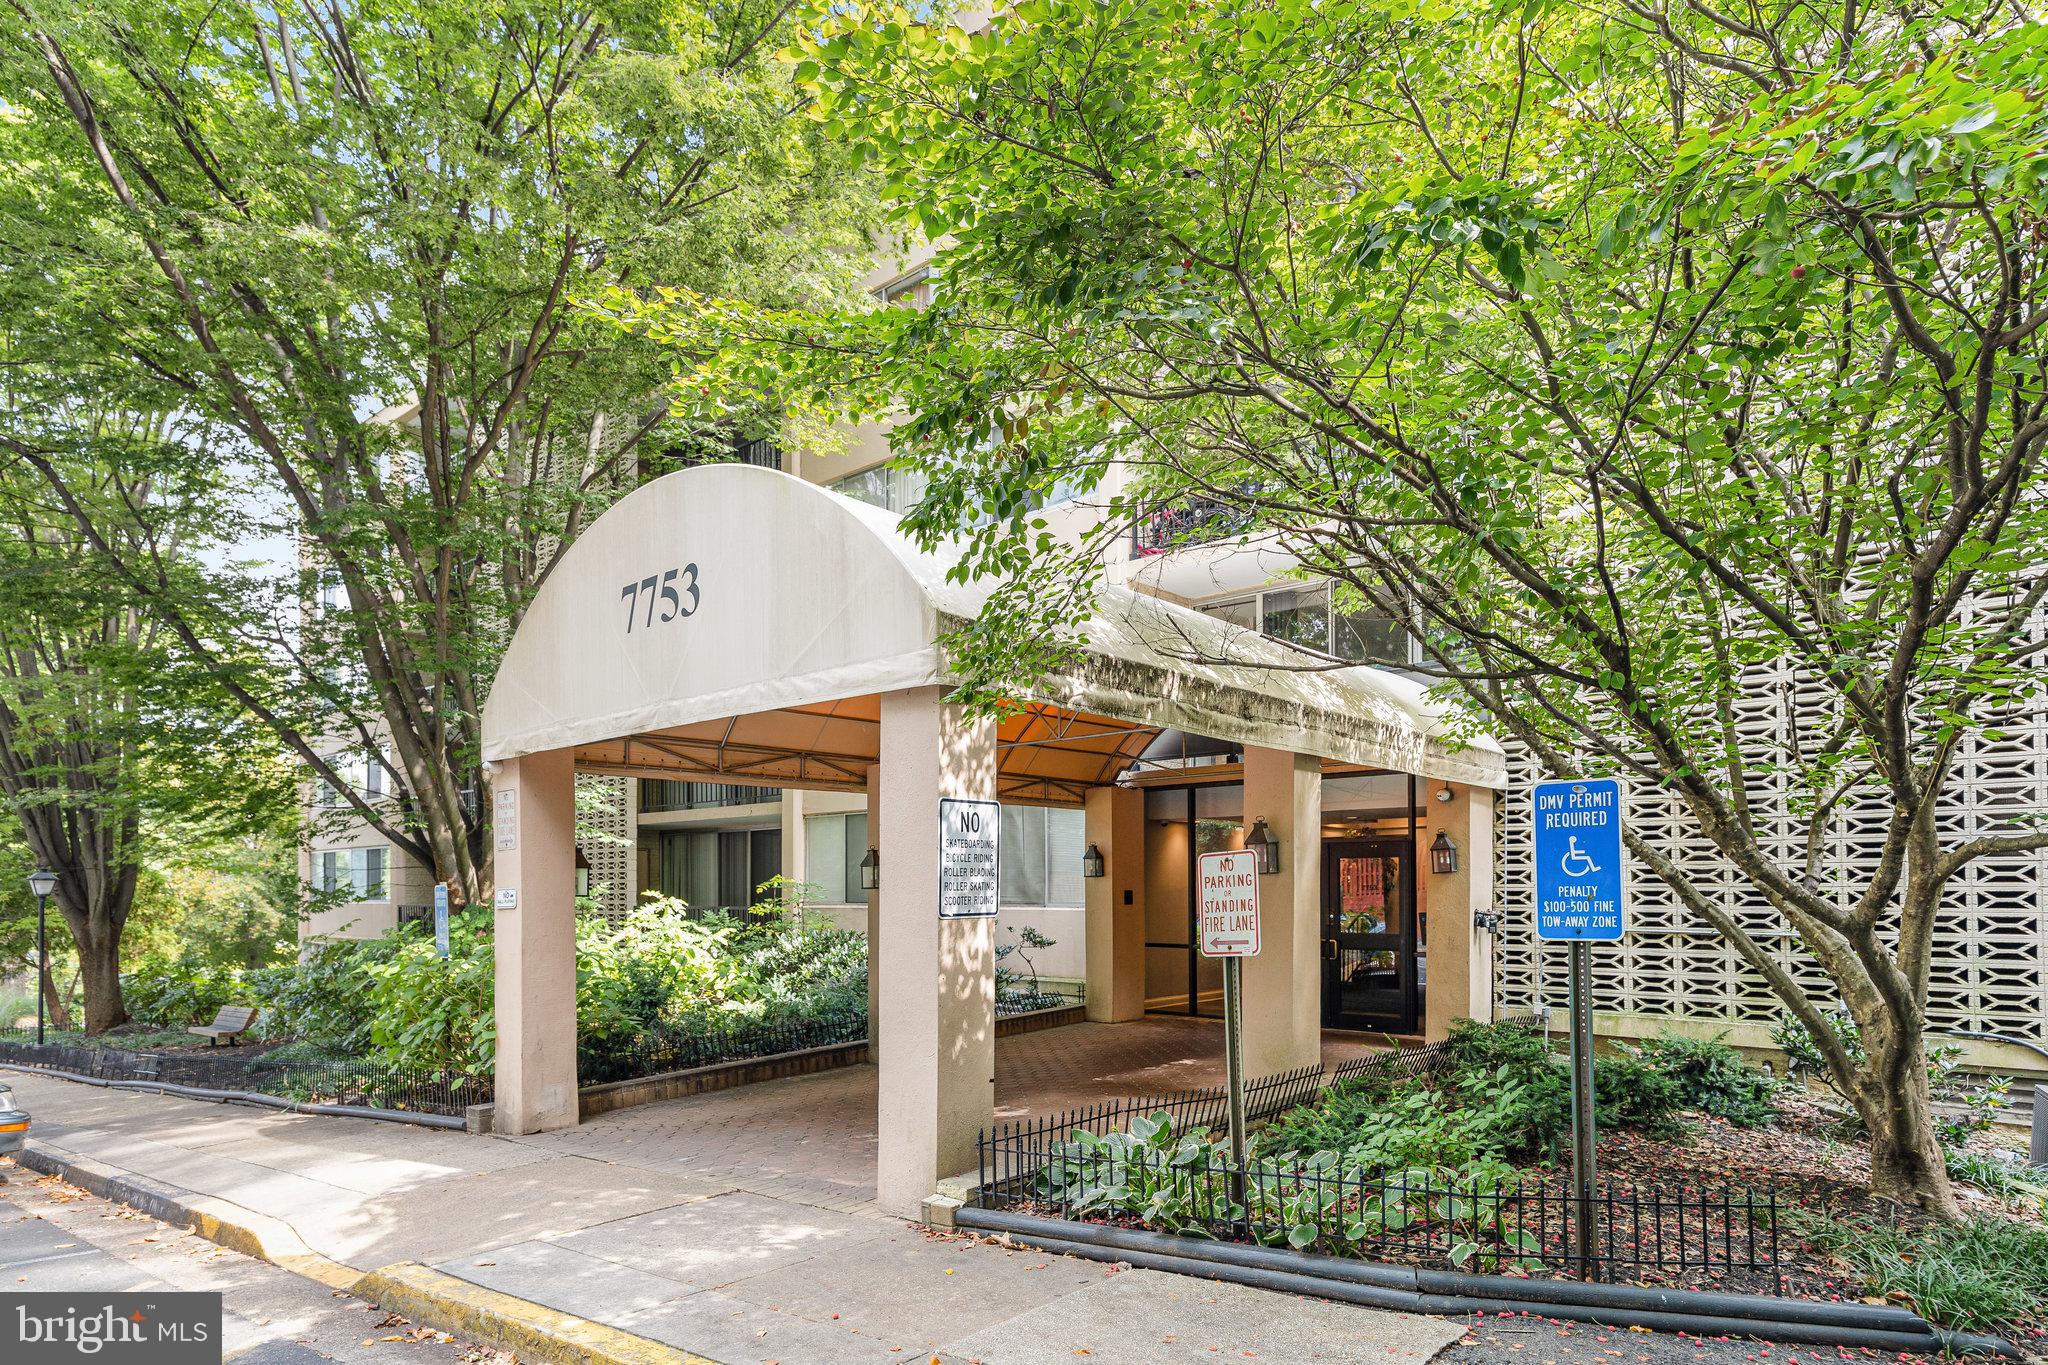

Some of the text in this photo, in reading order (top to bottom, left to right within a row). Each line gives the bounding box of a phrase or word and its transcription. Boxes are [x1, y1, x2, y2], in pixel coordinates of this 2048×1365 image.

[620, 562, 700, 634] 7753
[1539, 791, 1613, 810] DMV PERMIT
[960, 811, 980, 833] NO
[1546, 810, 1607, 829] REQUIRED
[945, 838, 995, 849] SKATEBOARDING
[945, 853, 994, 863] BICYCLE RIDING
[943, 867, 995, 877] ROLLER BLADING
[1219, 859, 1234, 872] NO
[943, 881, 995, 892] ROLLER SKATING
[1204, 873, 1252, 889] PARKING
[1558, 885, 1598, 898] PENALTY
[944, 895, 994, 906] SCOOTER RIDING
[1204, 898, 1253, 914] STANDING
[1543, 900, 1615, 913] $100-500 FINE
[1204, 915, 1255, 932] FIRE LANE
[1542, 915, 1618, 928] TOW-AWAY ZONE
